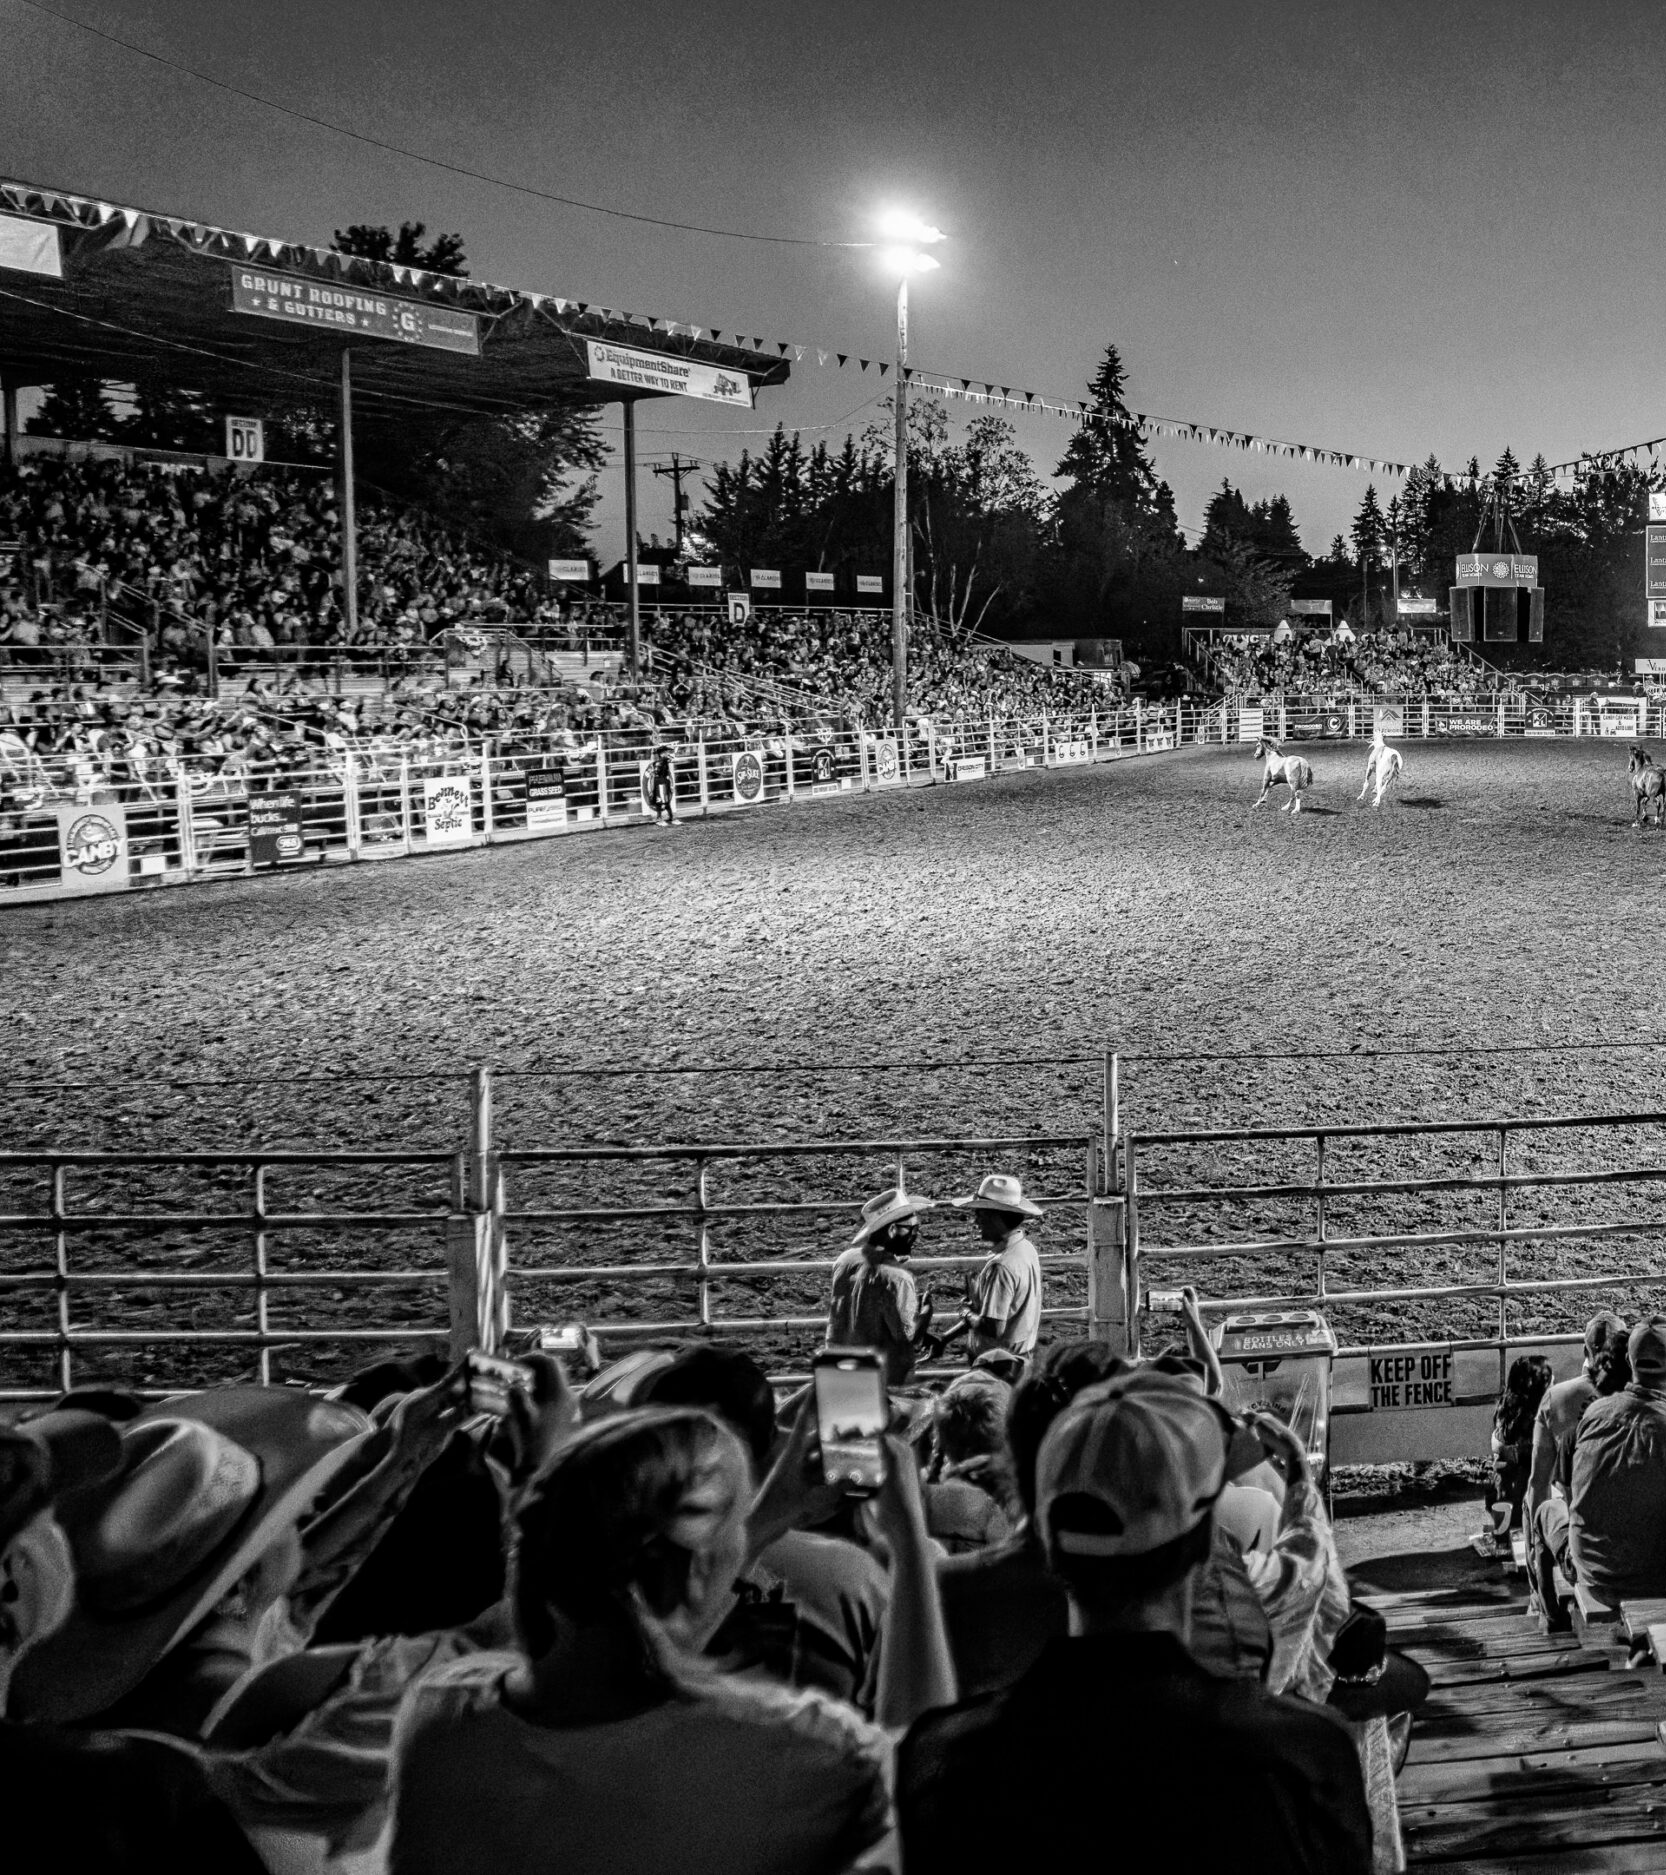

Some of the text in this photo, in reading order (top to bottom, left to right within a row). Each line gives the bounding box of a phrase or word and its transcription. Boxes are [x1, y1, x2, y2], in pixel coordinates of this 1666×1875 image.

[241, 274, 387, 316] GRUNT ROOFING
[284, 301, 356, 326] GUTTERS
[401, 312, 415, 331] G
[606, 350, 690, 378] EquipmentShare
[610, 367, 688, 393] A BETTER WAY TO RENT
[232, 428, 258, 459] DD
[733, 602, 744, 623] D
[1330, 717, 1339, 729] C
[428, 786, 469, 811] Bennett
[529, 785, 563, 797] GRASS SEED
[434, 817, 463, 833] Septic
[63, 838, 125, 868] CANBY
[1243, 1334, 1291, 1344] BOTTLES
[1243, 1337, 1304, 1350] CANS ONLY
[1370, 1354, 1452, 1384] KEEP OFF
[1371, 1381, 1453, 1408] THE FENCE
